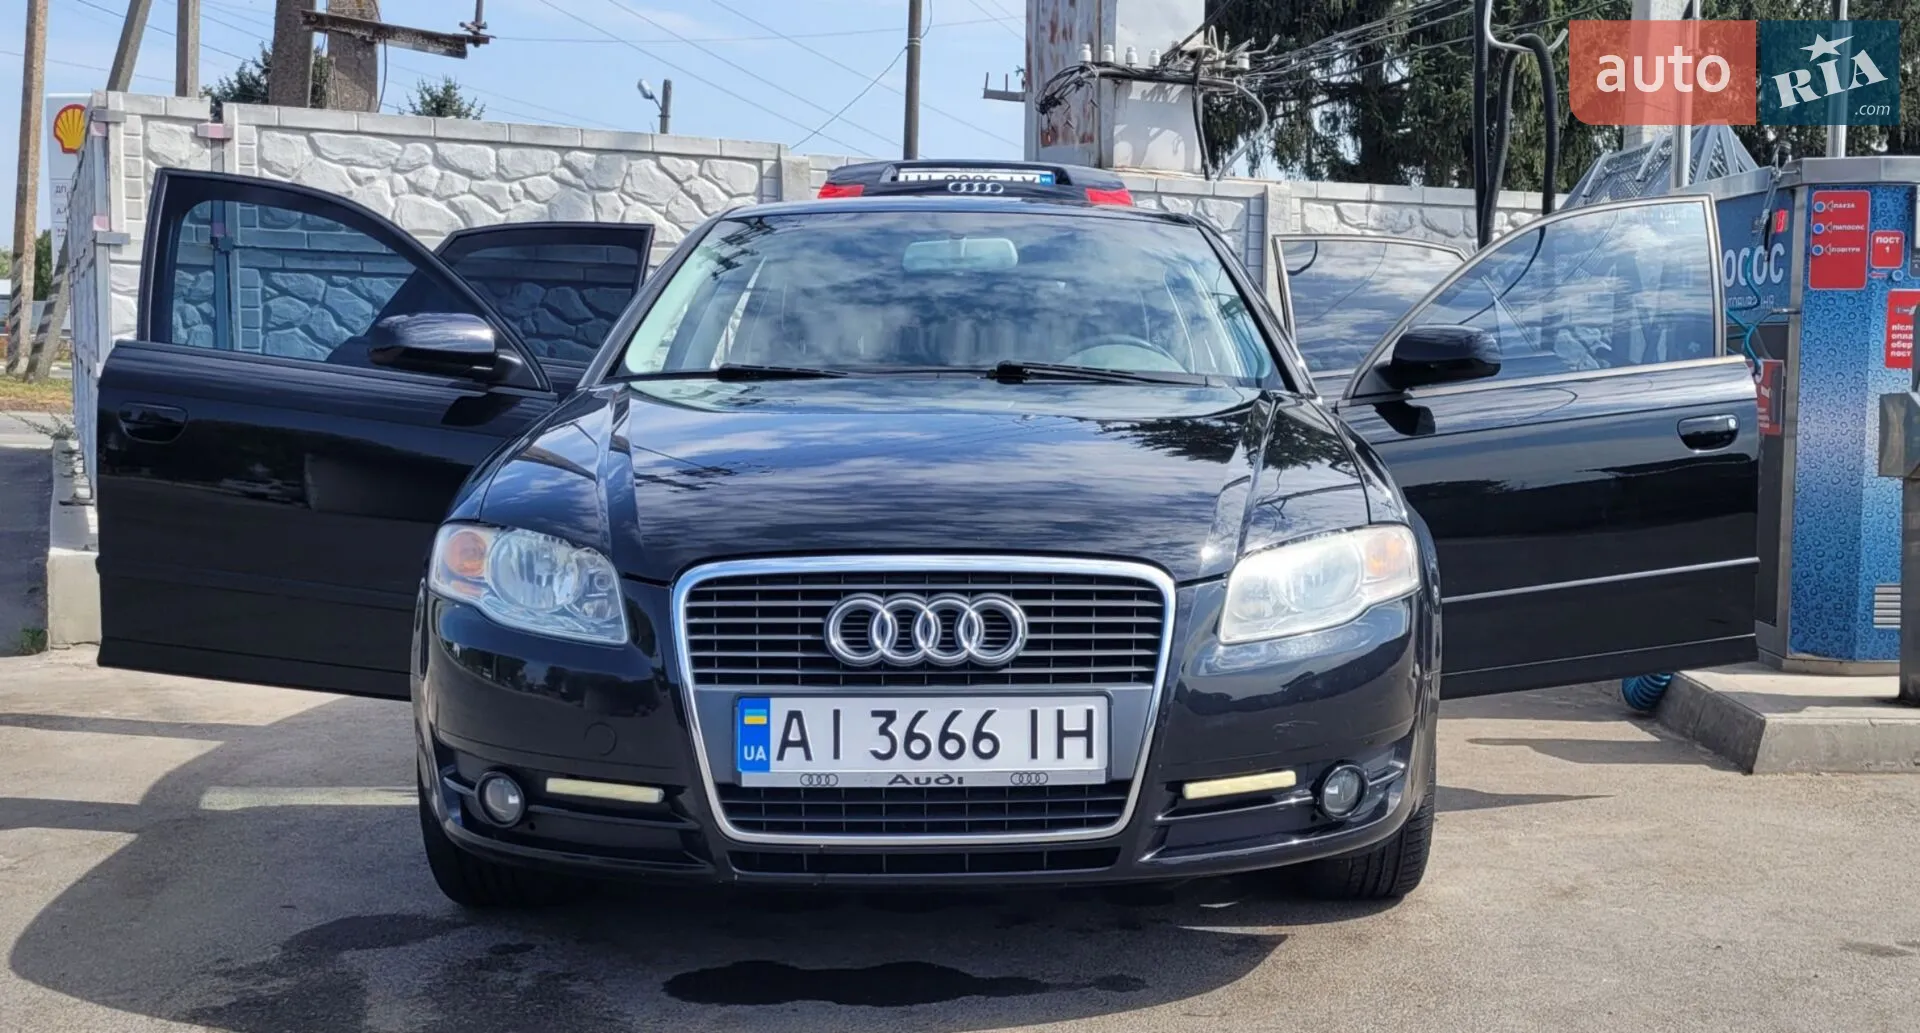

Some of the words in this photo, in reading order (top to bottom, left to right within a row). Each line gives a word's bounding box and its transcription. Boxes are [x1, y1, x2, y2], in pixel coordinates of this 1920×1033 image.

[1875, 236, 1900, 244] ПОСТ
[744, 745, 768, 761] UA
[776, 708, 843, 762] AI
[869, 708, 1001, 761] 3666
[1030, 708, 1095, 760] IH
[887, 774, 964, 786] Audi
